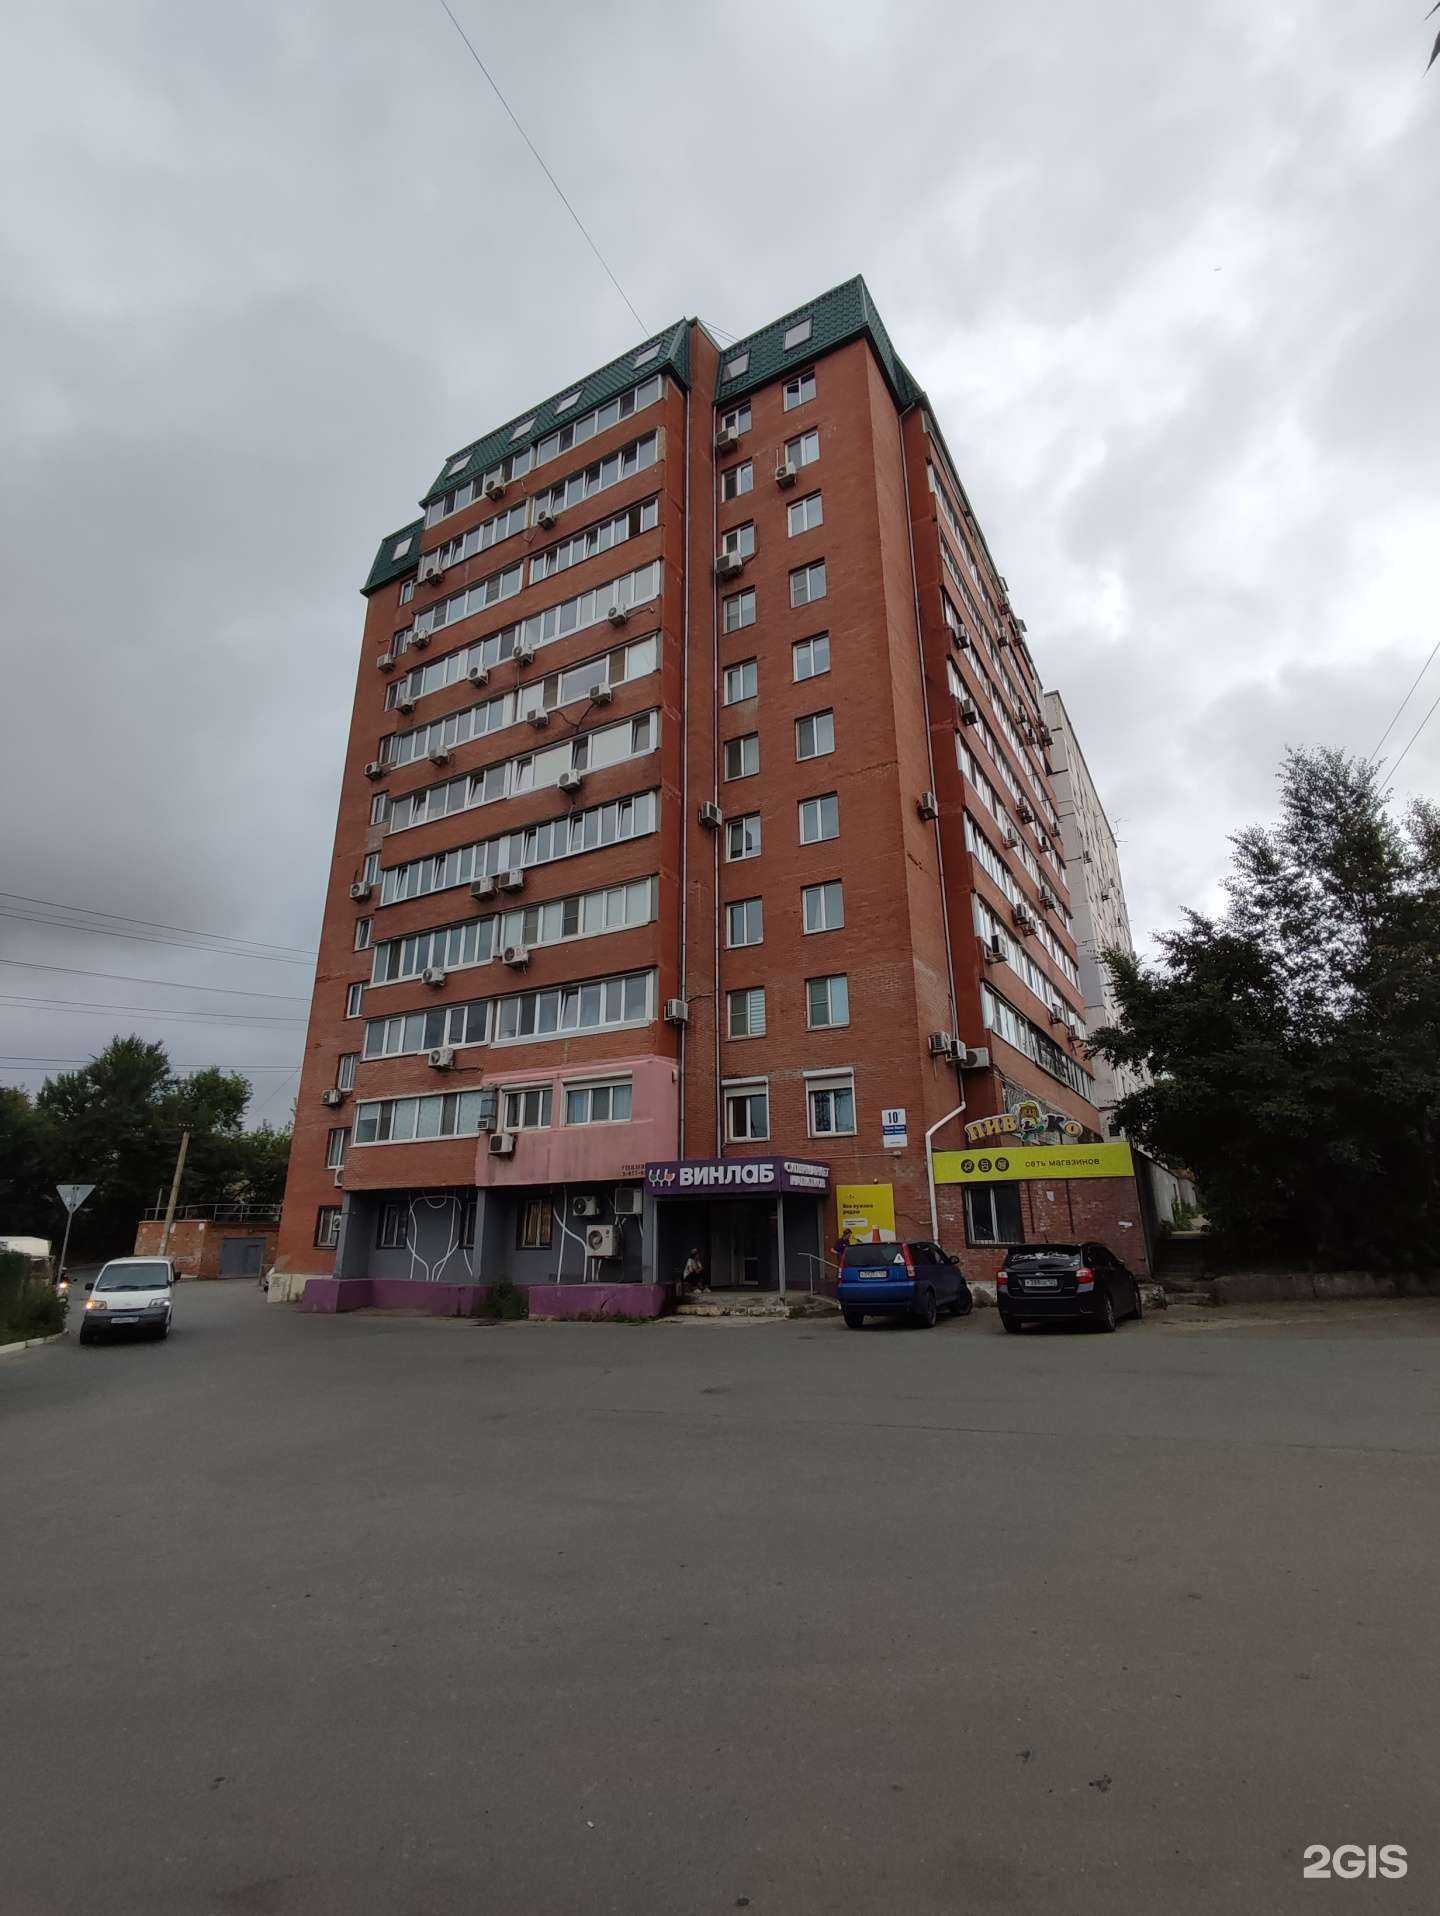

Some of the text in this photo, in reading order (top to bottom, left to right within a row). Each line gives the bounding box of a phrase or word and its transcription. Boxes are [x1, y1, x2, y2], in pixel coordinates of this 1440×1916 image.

[888, 1111, 898, 1123] 10
[1049, 1158, 1100, 1167] магазинов
[679, 1164, 775, 1187] ВИНЛАБ
